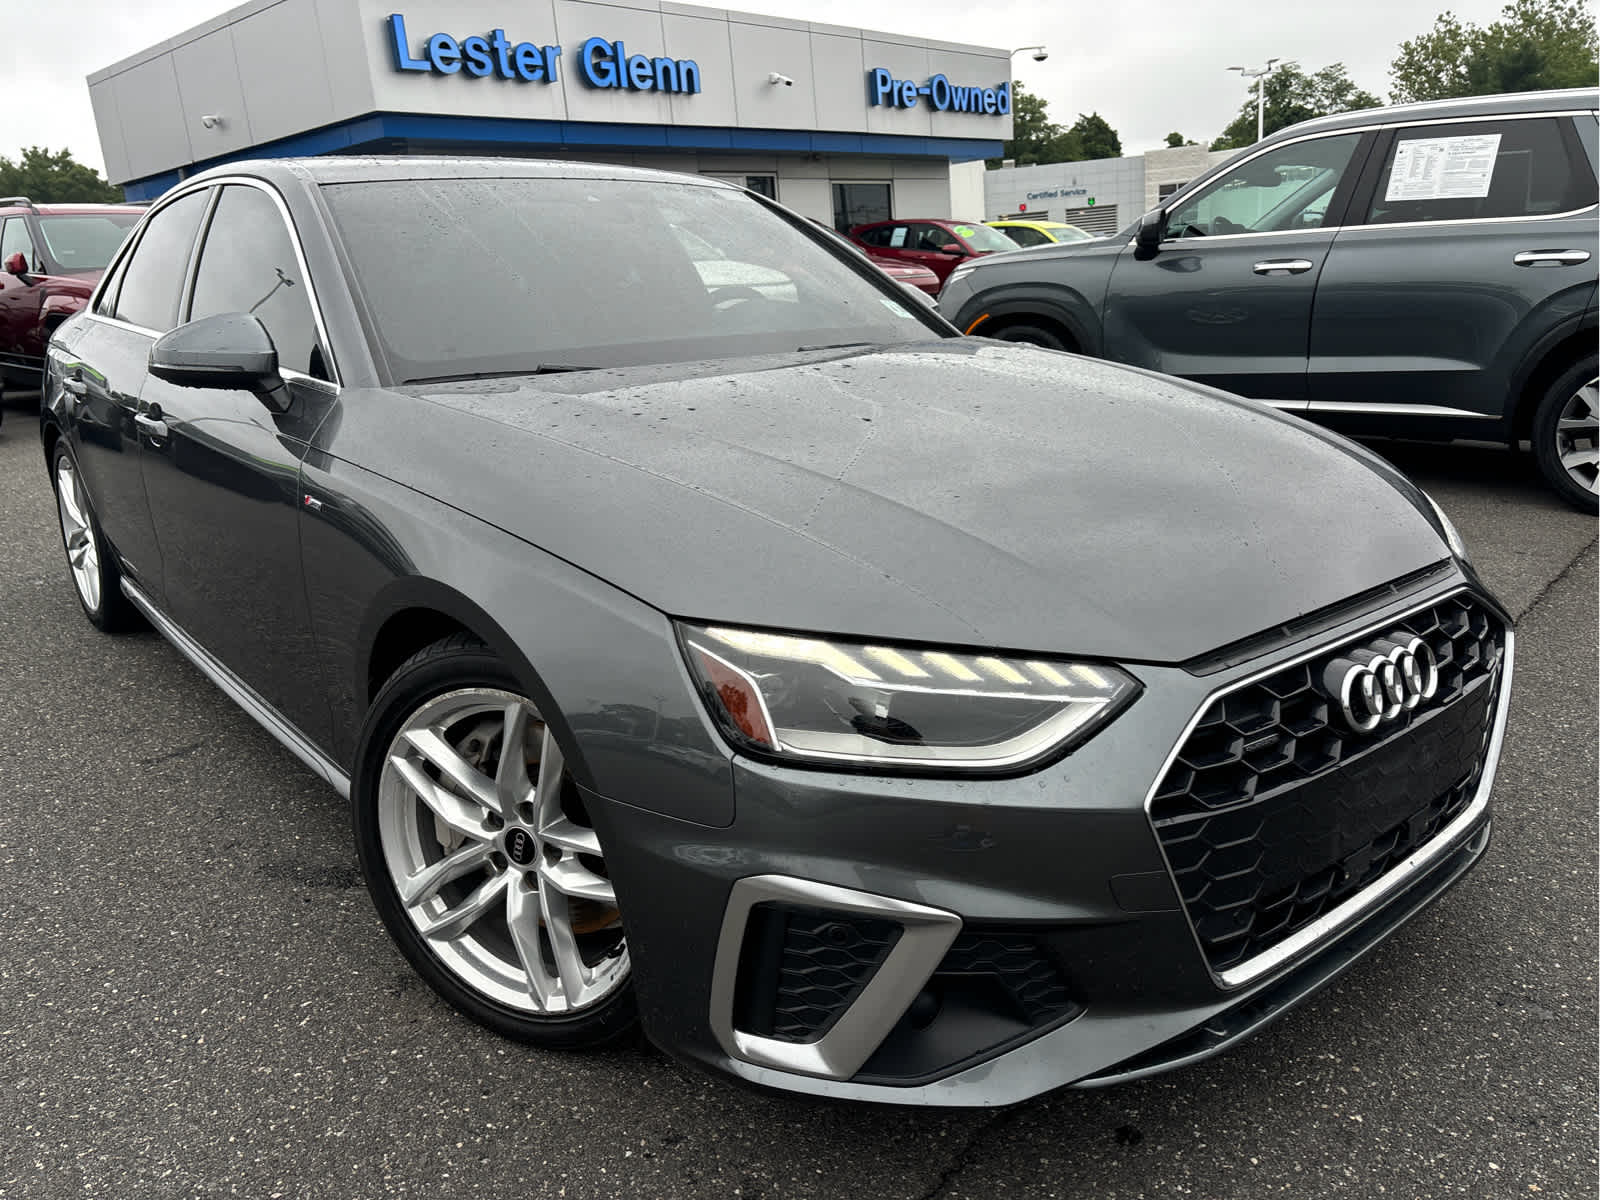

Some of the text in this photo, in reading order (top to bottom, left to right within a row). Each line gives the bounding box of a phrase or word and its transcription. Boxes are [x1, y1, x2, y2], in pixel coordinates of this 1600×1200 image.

[387, 13, 701, 94] Lester Glenn
[869, 67, 1010, 115] Pre-Owned
[1026, 188, 1087, 201] Certified Service
